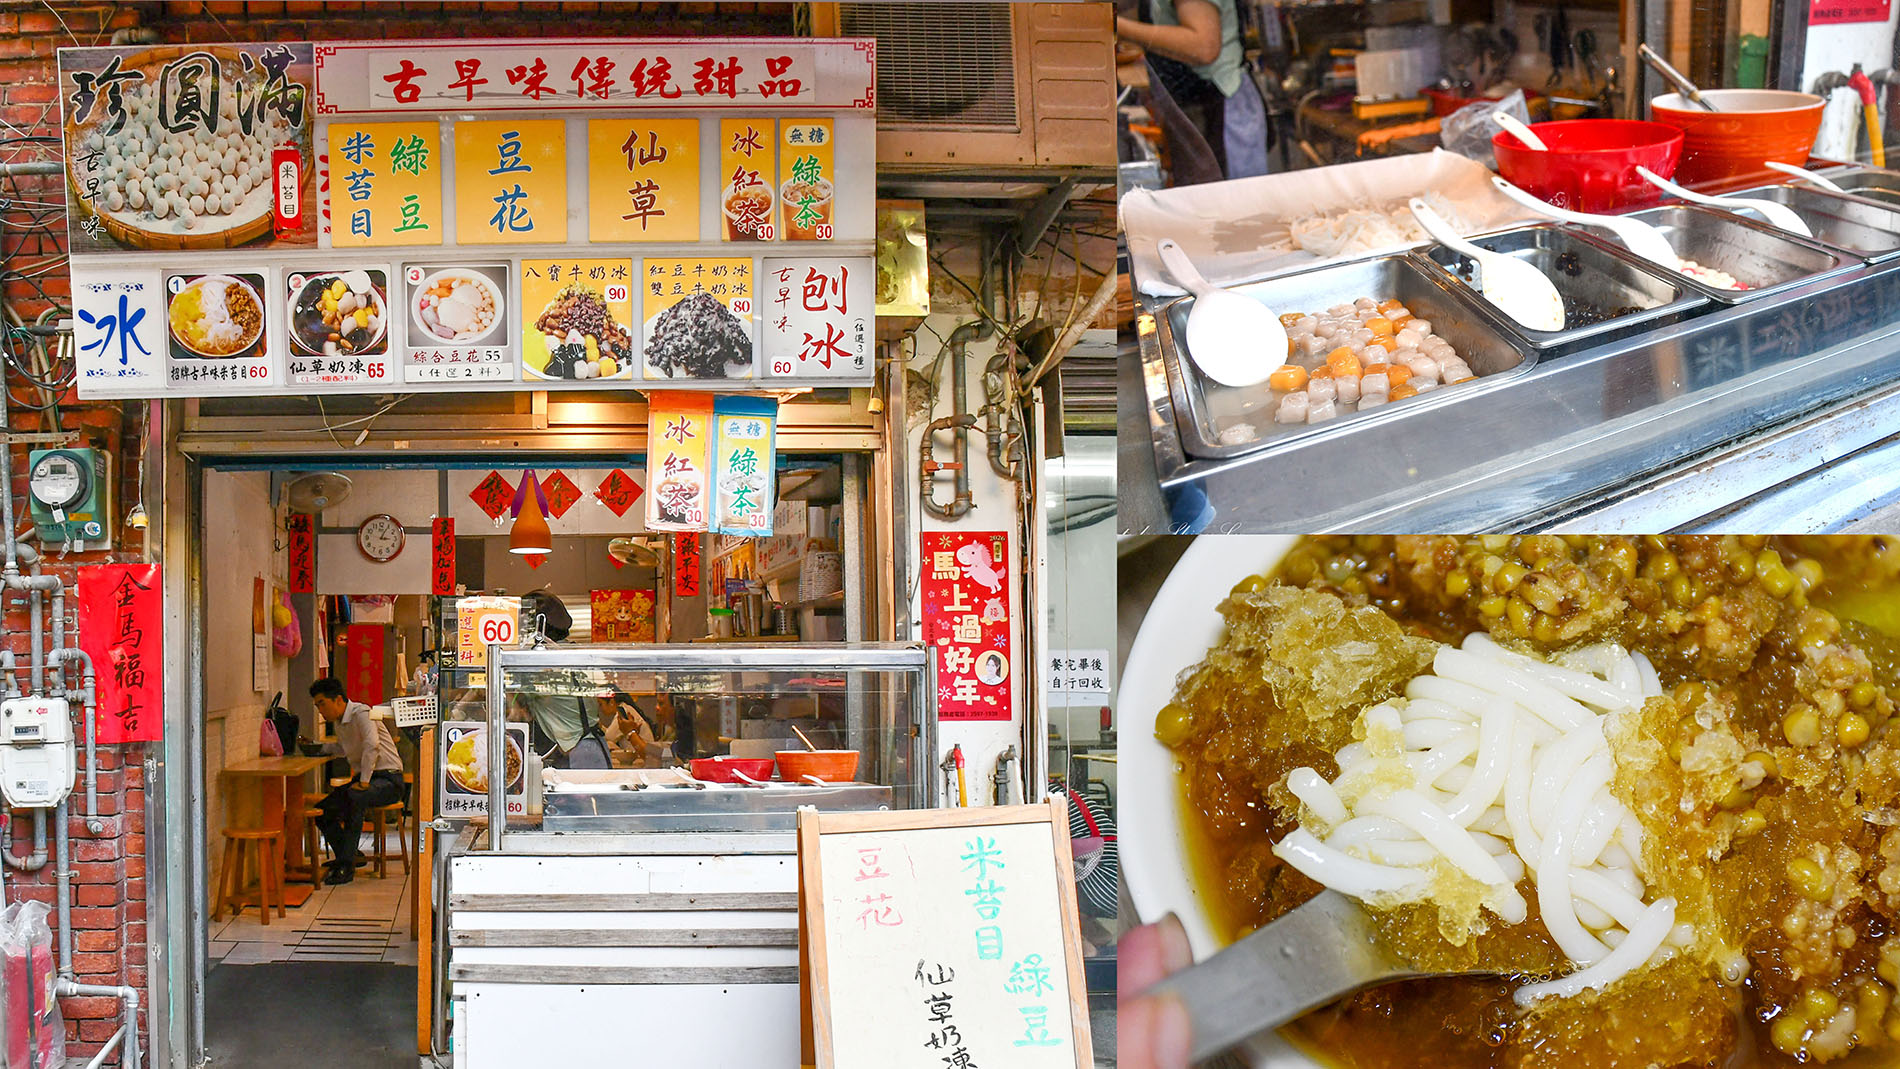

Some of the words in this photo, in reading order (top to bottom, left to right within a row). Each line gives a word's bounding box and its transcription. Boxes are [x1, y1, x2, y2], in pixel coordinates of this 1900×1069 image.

[70, 44, 306, 138] 珍圓滿
[383, 56, 802, 104] 古早味傳統甜品
[789, 127, 825, 144] 無糖
[281, 164, 296, 215] 米苔目
[340, 131, 376, 238] 米苔目
[389, 135, 431, 233] 綠豆
[488, 131, 535, 233] 豆花
[621, 129, 668, 231] 仙草
[731, 126, 765, 234] 冰紅茶
[77, 149, 107, 242] 古早味
[791, 154, 823, 230] 綠茶
[758, 225, 774, 239] 30
[816, 225, 833, 239] 30
[409, 269, 420, 281] 3
[525, 264, 629, 282] 八寶牛奶冰
[649, 264, 750, 278] 紅豆牛奶冰
[172, 279, 180, 291] 1
[292, 277, 302, 289] 2
[608, 287, 626, 300] 90
[650, 281, 749, 297] 雙豆牛奶冰
[733, 300, 751, 313] 80
[771, 266, 796, 333] 古早味
[797, 265, 854, 370] 刨冰
[77, 294, 152, 366] 冰
[413, 349, 480, 364] 綜合豆花
[484, 350, 501, 361] 55
[774, 360, 792, 374] 60
[170, 364, 247, 381] 招牌古早味米苔目
[249, 366, 268, 378] 60
[289, 358, 366, 375] 仙草奶凍
[367, 362, 385, 379] 65
[727, 422, 761, 437] 無糖
[663, 415, 696, 517] 冰紅茶
[728, 447, 758, 517] 綠茶
[686, 509, 702, 523] 30
[750, 514, 766, 528] 30
[483, 619, 512, 643] 60
[931, 550, 982, 706] 馬上過好年
[109, 571, 152, 733] 金馬福吉
[1047, 677, 1104, 689] 自行回收
[452, 730, 458, 741] 1
[507, 802, 523, 813] 60
[854, 847, 904, 931] 豆花
[960, 835, 1007, 961] 米苔目
[1003, 952, 1065, 1048] 綠豆
